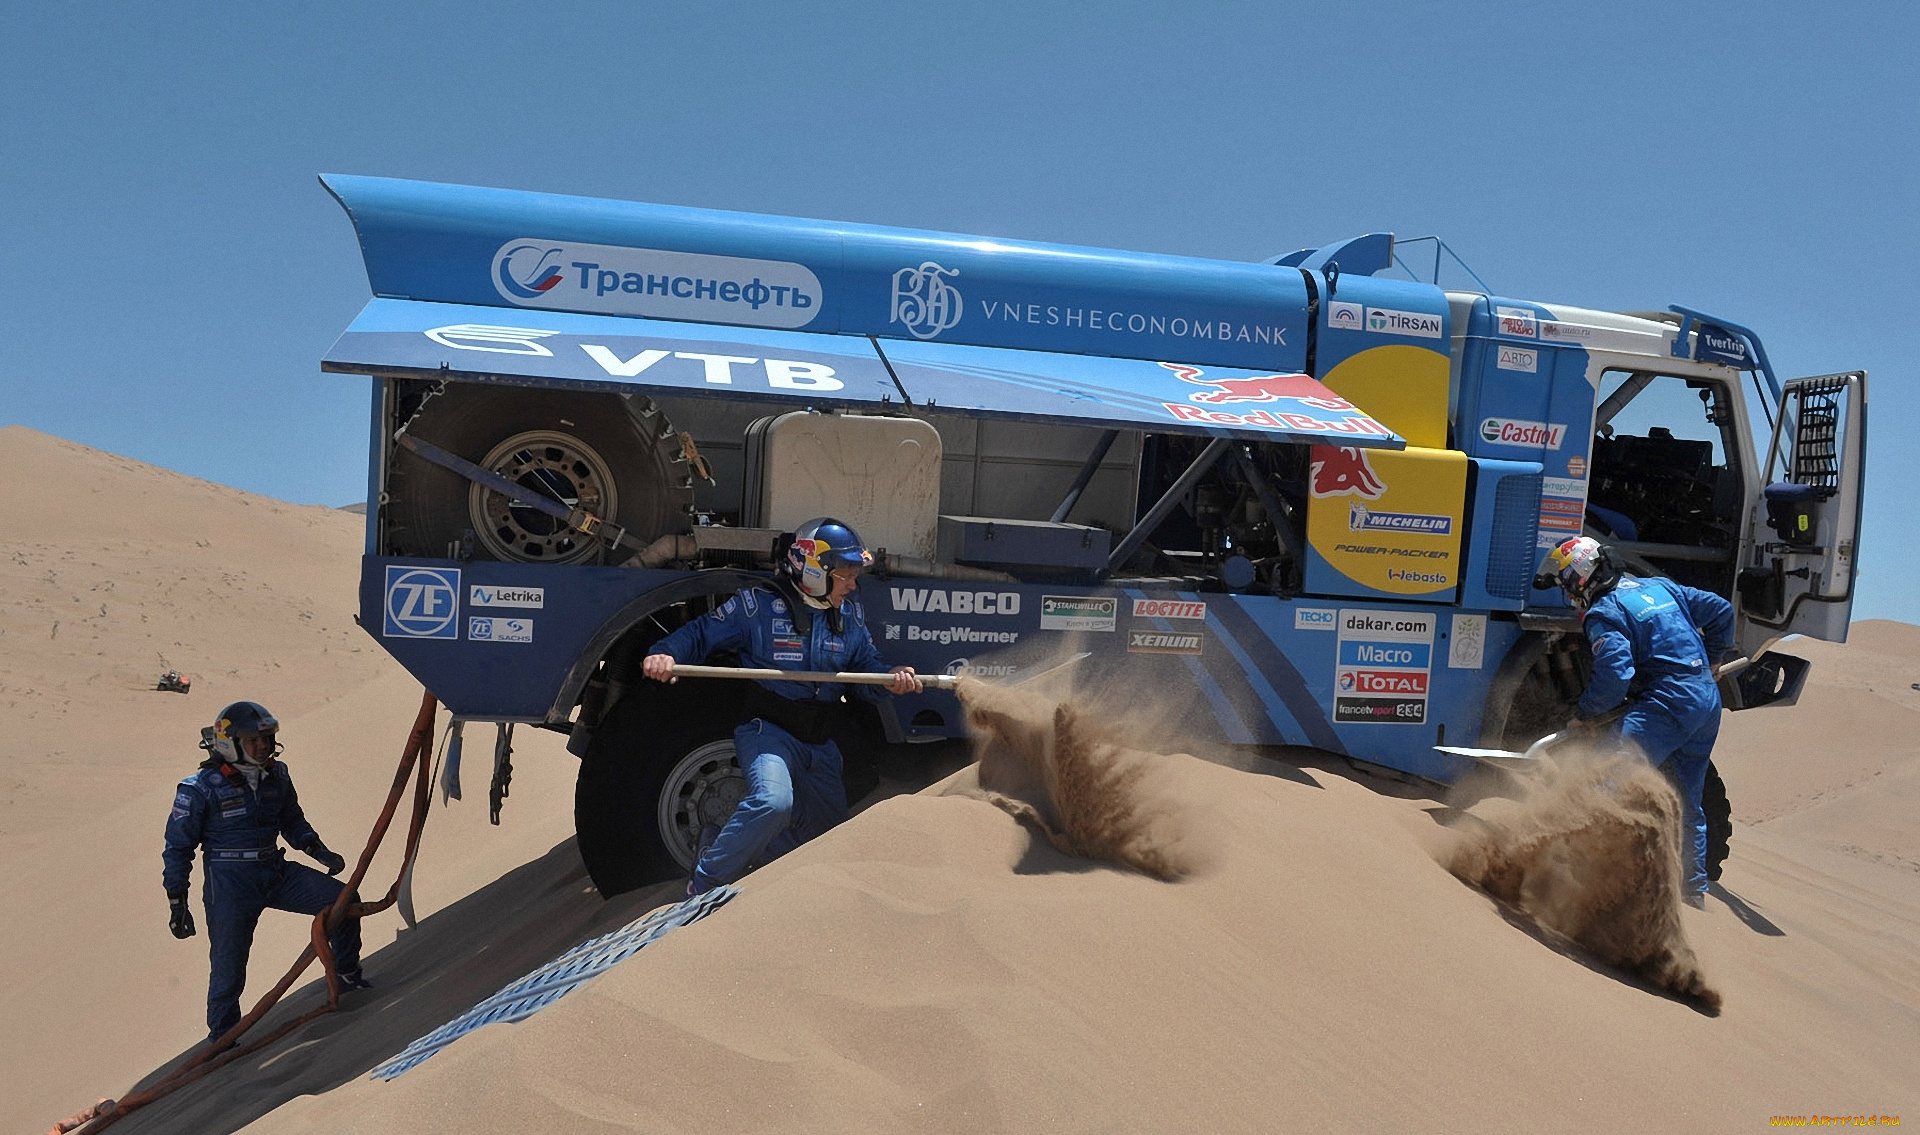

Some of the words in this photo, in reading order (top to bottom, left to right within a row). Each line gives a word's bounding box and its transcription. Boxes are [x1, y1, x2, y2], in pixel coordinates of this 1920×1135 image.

[572, 261, 812, 310] Транснефть
[982, 300, 1288, 346] VNESHECONOMBANK
[1705, 334, 1745, 355] TverTrip
[579, 344, 844, 391] VTB
[1162, 402, 1288, 429] Red
[1274, 411, 1391, 435] Bull
[1501, 423, 1558, 445] Castrol
[1370, 515, 1448, 529] MICHELIN
[1334, 544, 1449, 558] POWER-PACKER
[1388, 568, 1447, 583] Webasto
[394, 583, 450, 621] ZF
[496, 589, 542, 603] Letrika
[890, 587, 1021, 615] WABCO
[1136, 601, 1203, 617] LOCTITE
[472, 622, 491, 634] ZF
[1346, 616, 1427, 633] dakar.com
[908, 626, 1018, 645] BorgWarner
[1357, 645, 1412, 663] Macro
[1359, 673, 1424, 691] TOTAL
